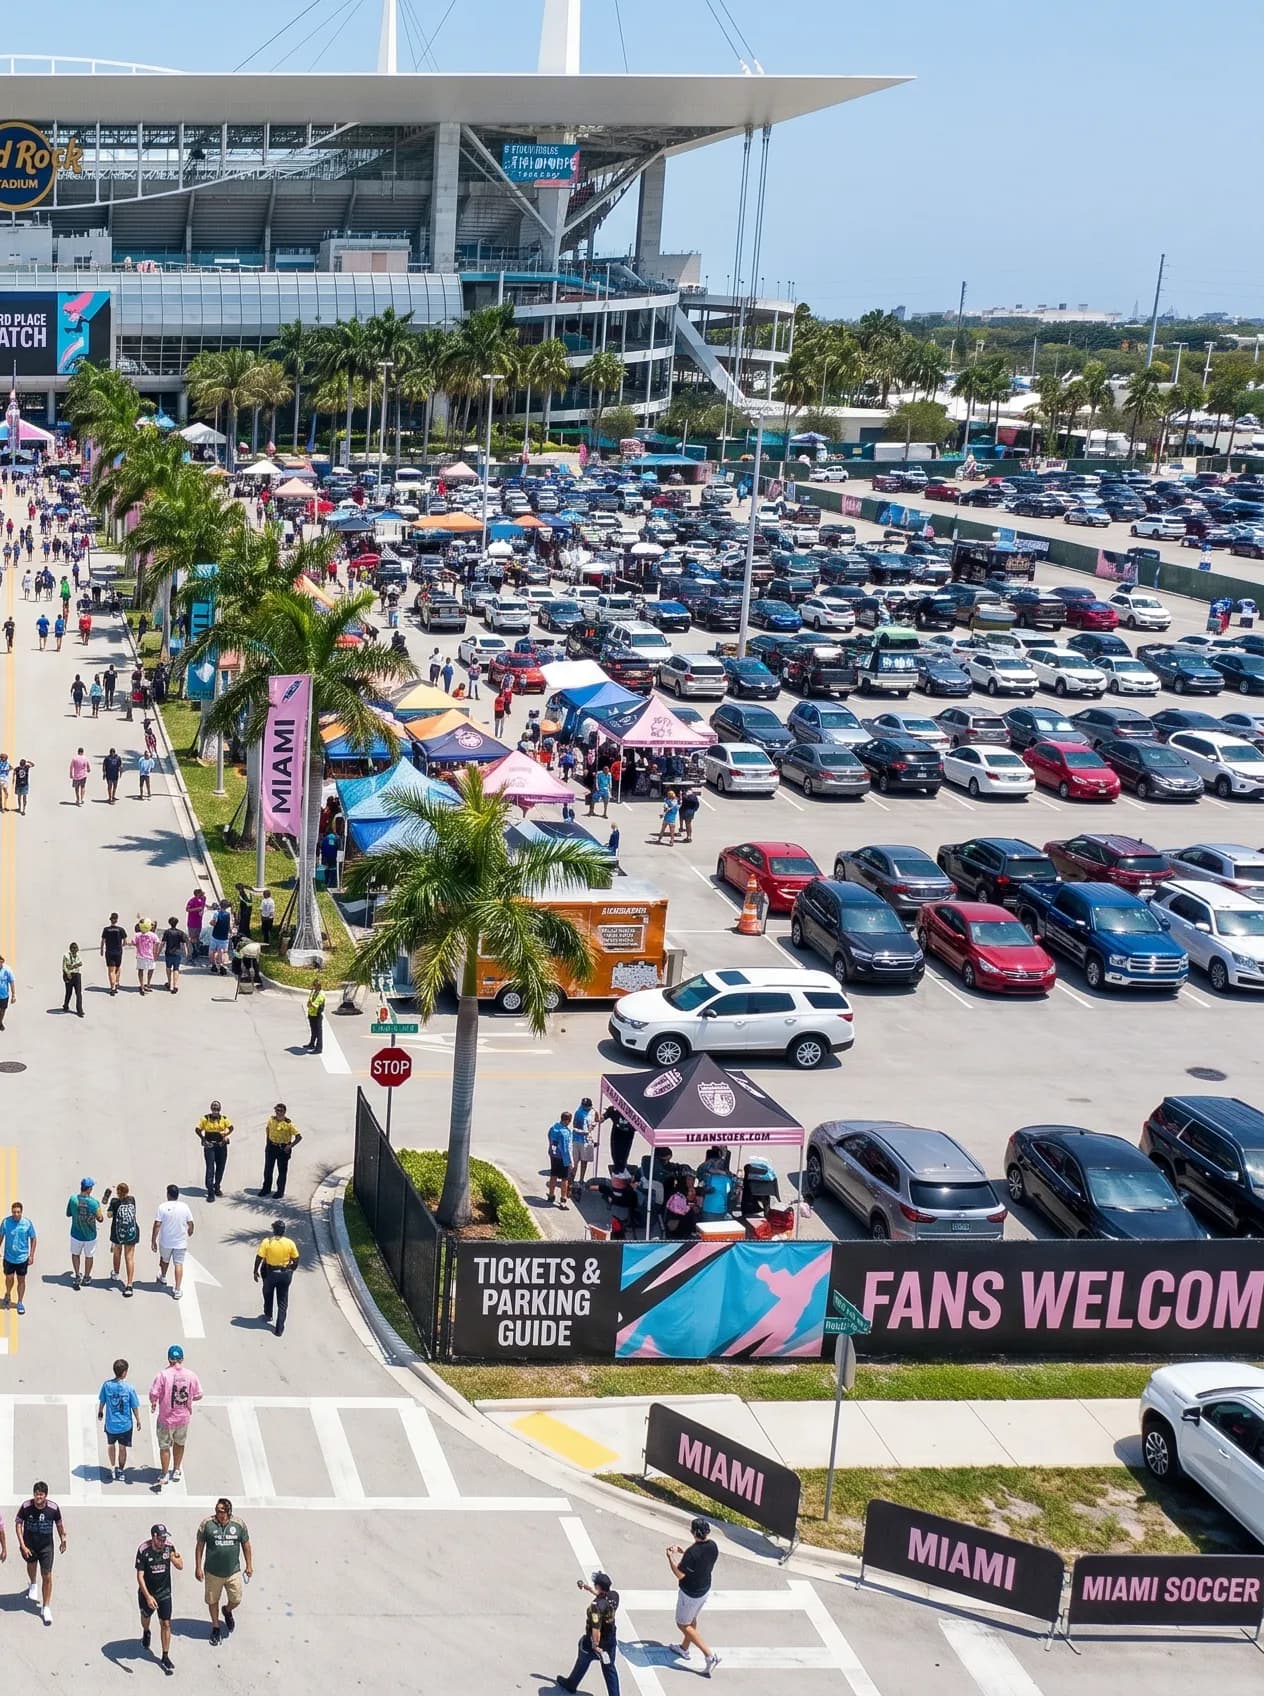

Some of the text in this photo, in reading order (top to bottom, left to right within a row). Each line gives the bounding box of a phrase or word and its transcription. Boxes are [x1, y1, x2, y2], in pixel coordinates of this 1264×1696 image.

[15, 137, 84, 175] Rock
[14, 313, 47, 326] PLACE
[272, 719, 295, 813] MIAMI
[373, 1060, 410, 1075] STOP
[473, 1257, 601, 1285] TICKETS &
[482, 1288, 591, 1316] PARKING
[862, 1270, 1005, 1330] FANS
[1021, 1270, 1264, 1329] WELCOM
[497, 1319, 573, 1347] GUIDE
[678, 1432, 765, 1506] MIAMI
[907, 1527, 1017, 1591] MIAMI
[1081, 1576, 1261, 1603] MIAMI SOCCER
